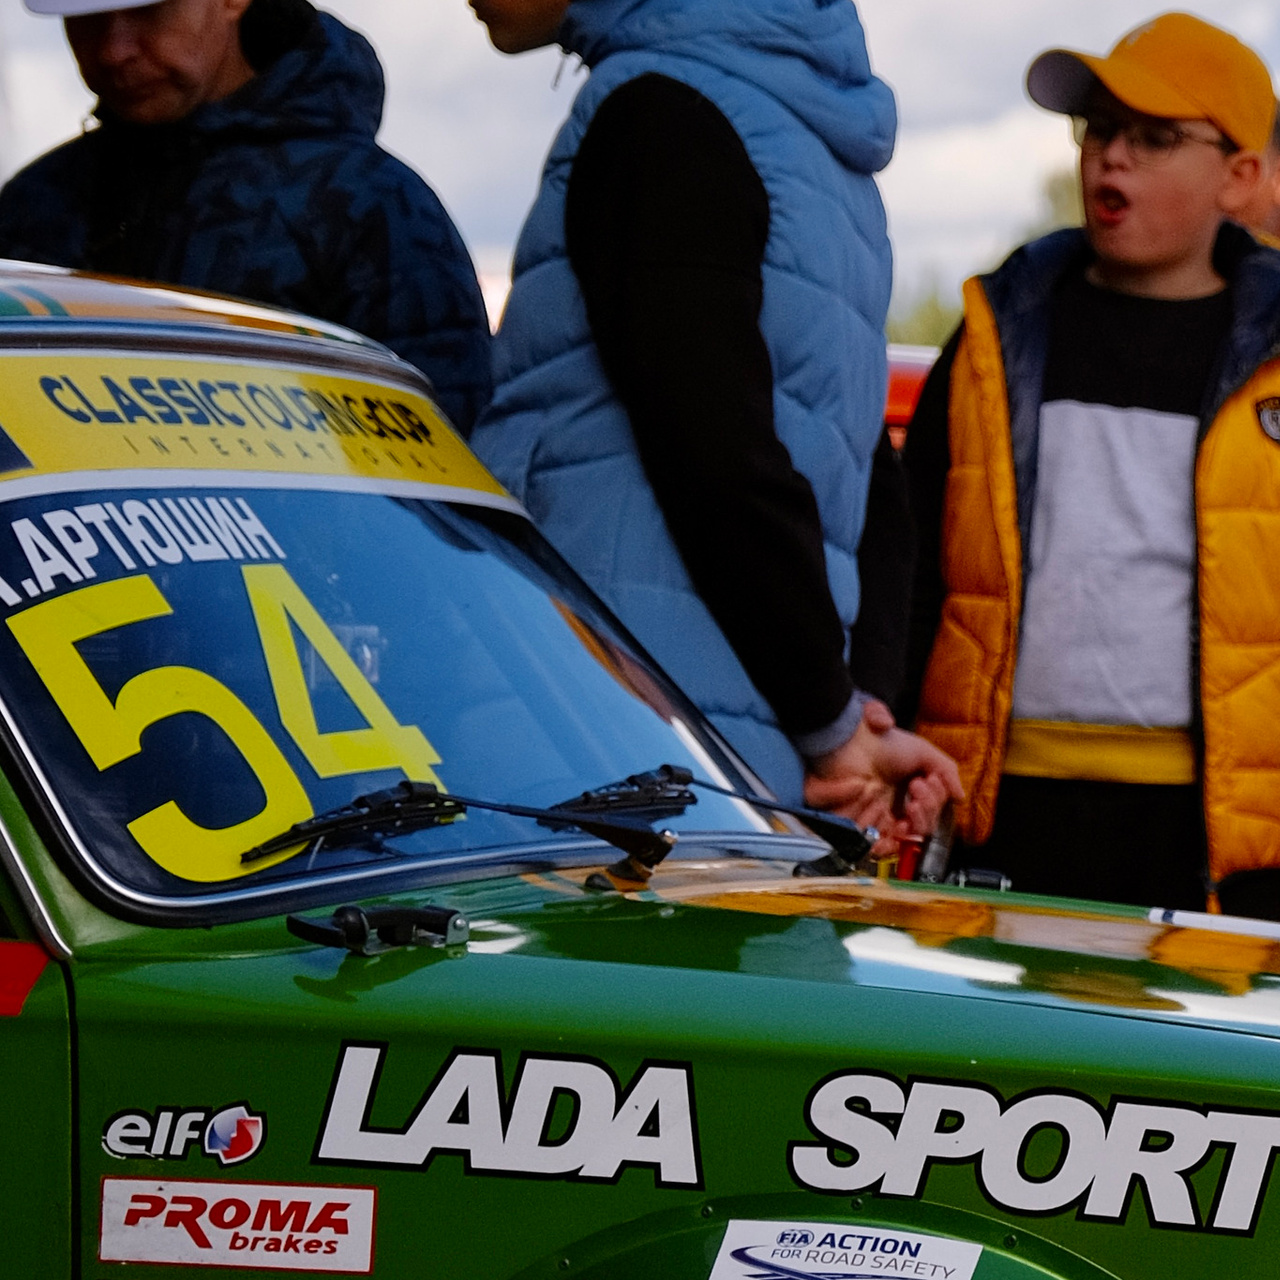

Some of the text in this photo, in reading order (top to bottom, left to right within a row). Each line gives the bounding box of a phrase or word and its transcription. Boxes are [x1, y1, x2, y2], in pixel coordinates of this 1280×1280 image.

[0, 497, 287, 607] .АРТЮШИН
[5, 563, 466, 883] 54
[103, 1110, 206, 1156] elf
[316, 1044, 700, 1186] LADA
[123, 1193, 351, 1249] PROMA
[228, 1231, 338, 1255] brakes
[778, 1230, 922, 1258] FIA ACTION
[770, 1248, 957, 1280] FOR ROAD SAFETY
